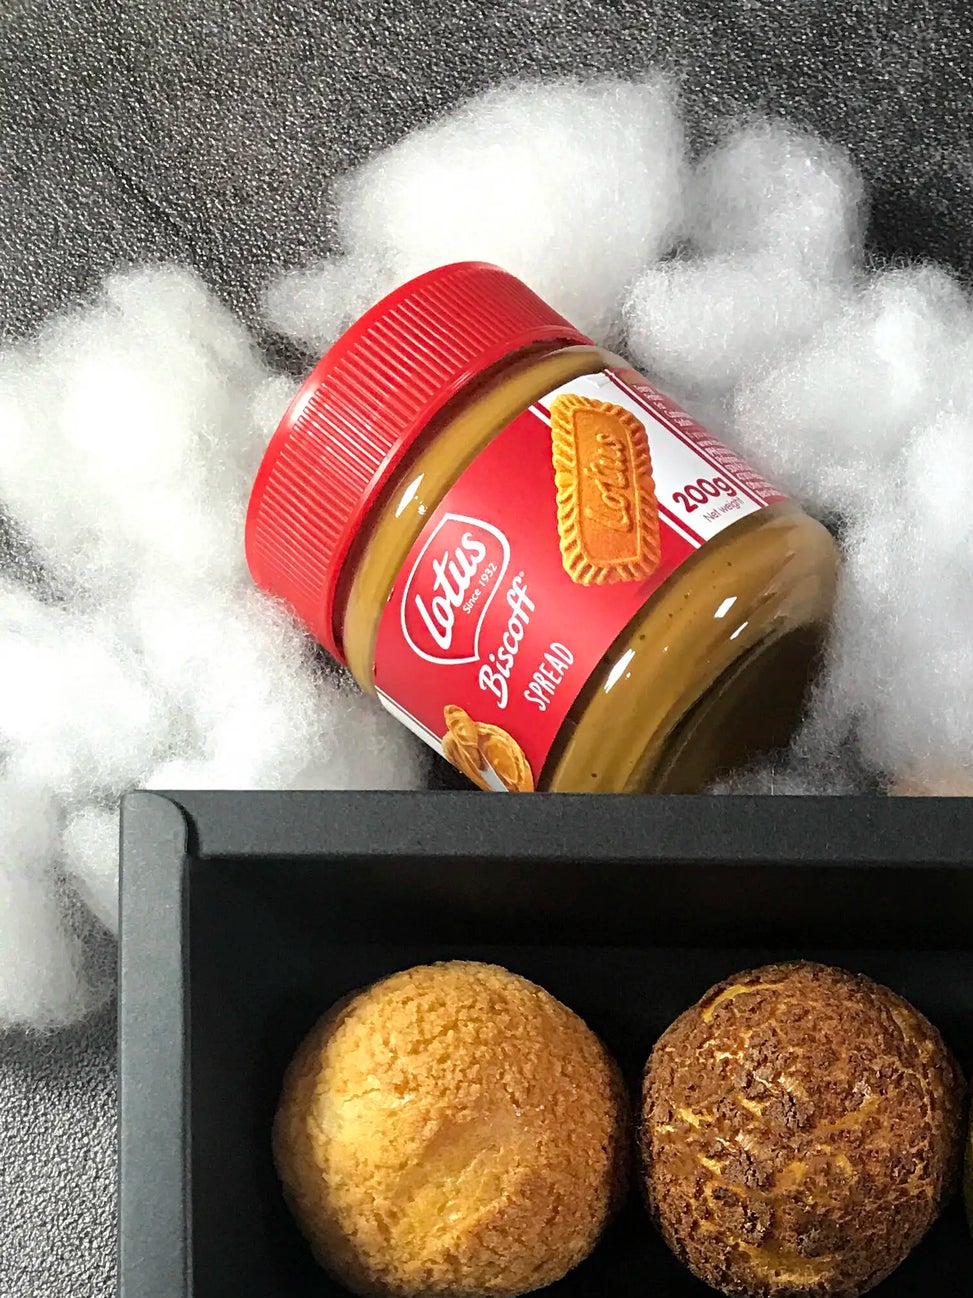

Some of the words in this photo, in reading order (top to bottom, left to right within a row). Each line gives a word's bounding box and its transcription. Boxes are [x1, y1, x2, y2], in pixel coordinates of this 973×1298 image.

[671, 476, 738, 514] 200g
[702, 508, 720, 523] Net
[719, 496, 745, 517] weight
[462, 589, 482, 615] Since
[479, 561, 498, 587] 1932
[478, 575, 535, 709] Biscoff
[523, 641, 574, 712] SPREAD
